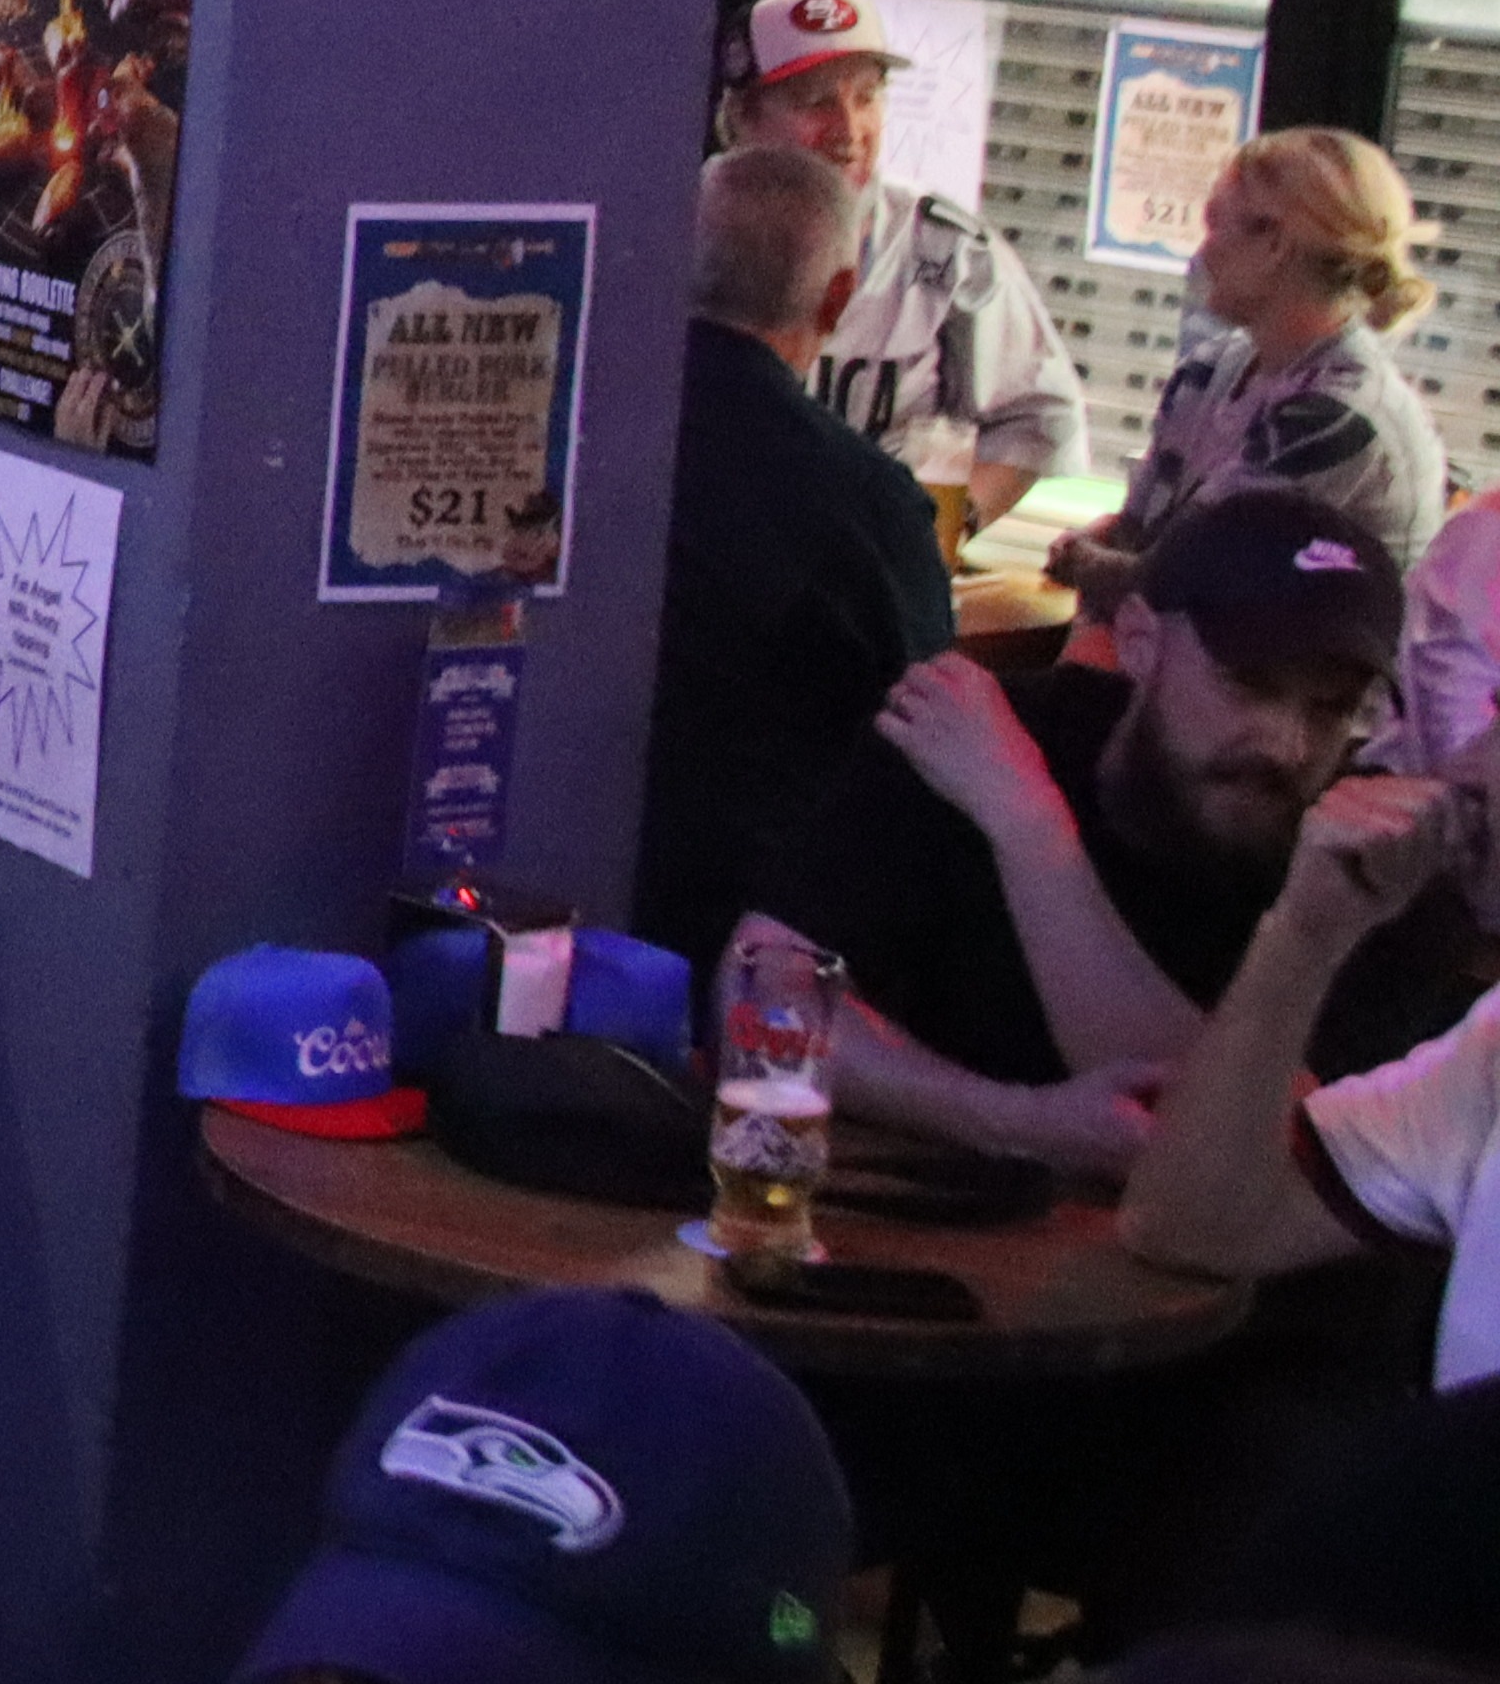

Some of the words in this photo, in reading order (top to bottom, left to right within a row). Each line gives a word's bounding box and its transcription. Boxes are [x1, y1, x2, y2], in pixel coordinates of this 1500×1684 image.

[1130, 90, 1171, 114] ALL
[1177, 96, 1227, 120] NEW
[1143, 196, 1190, 226] $21
[20, 269, 76, 316] ROULETTE
[388, 313, 454, 345] ALL
[460, 312, 542, 345] NEW
[409, 486, 487, 529] $21
